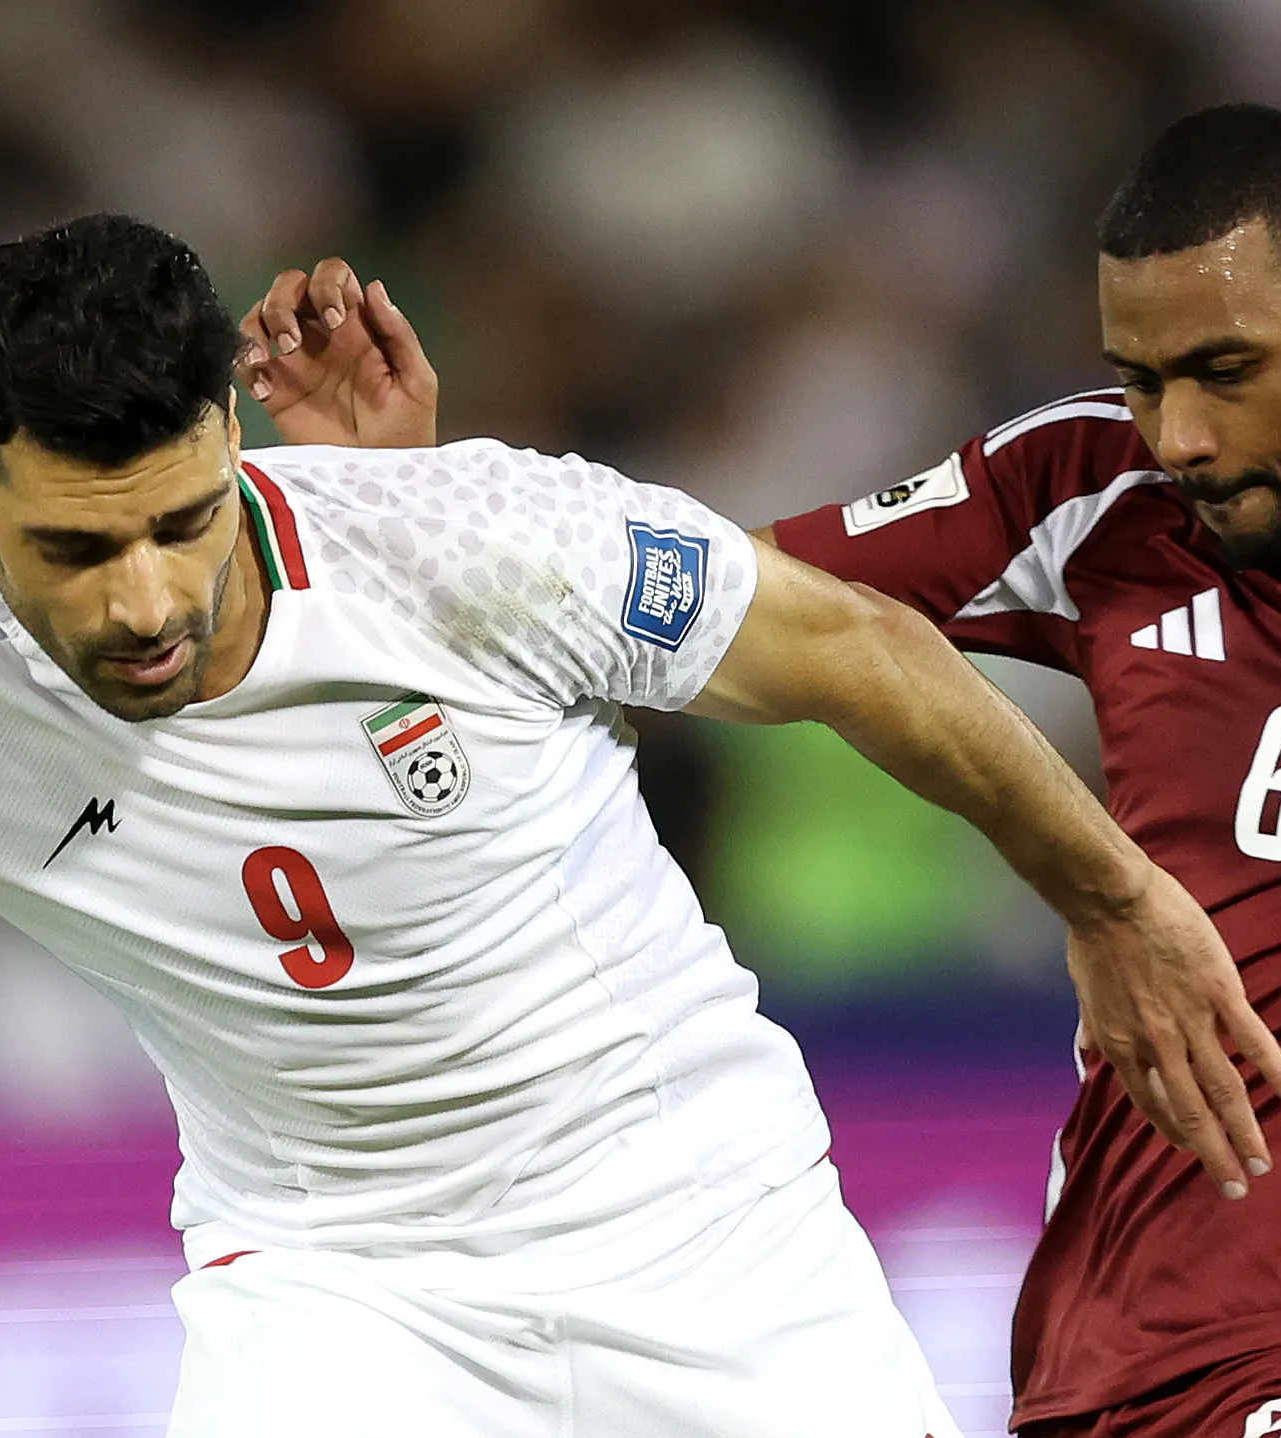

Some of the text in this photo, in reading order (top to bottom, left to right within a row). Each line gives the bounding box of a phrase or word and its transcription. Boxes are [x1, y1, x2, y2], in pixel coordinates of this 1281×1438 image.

[638, 546, 659, 613] FOOTBALL
[650, 548, 674, 618] UNITES
[241, 845, 355, 989] 9
